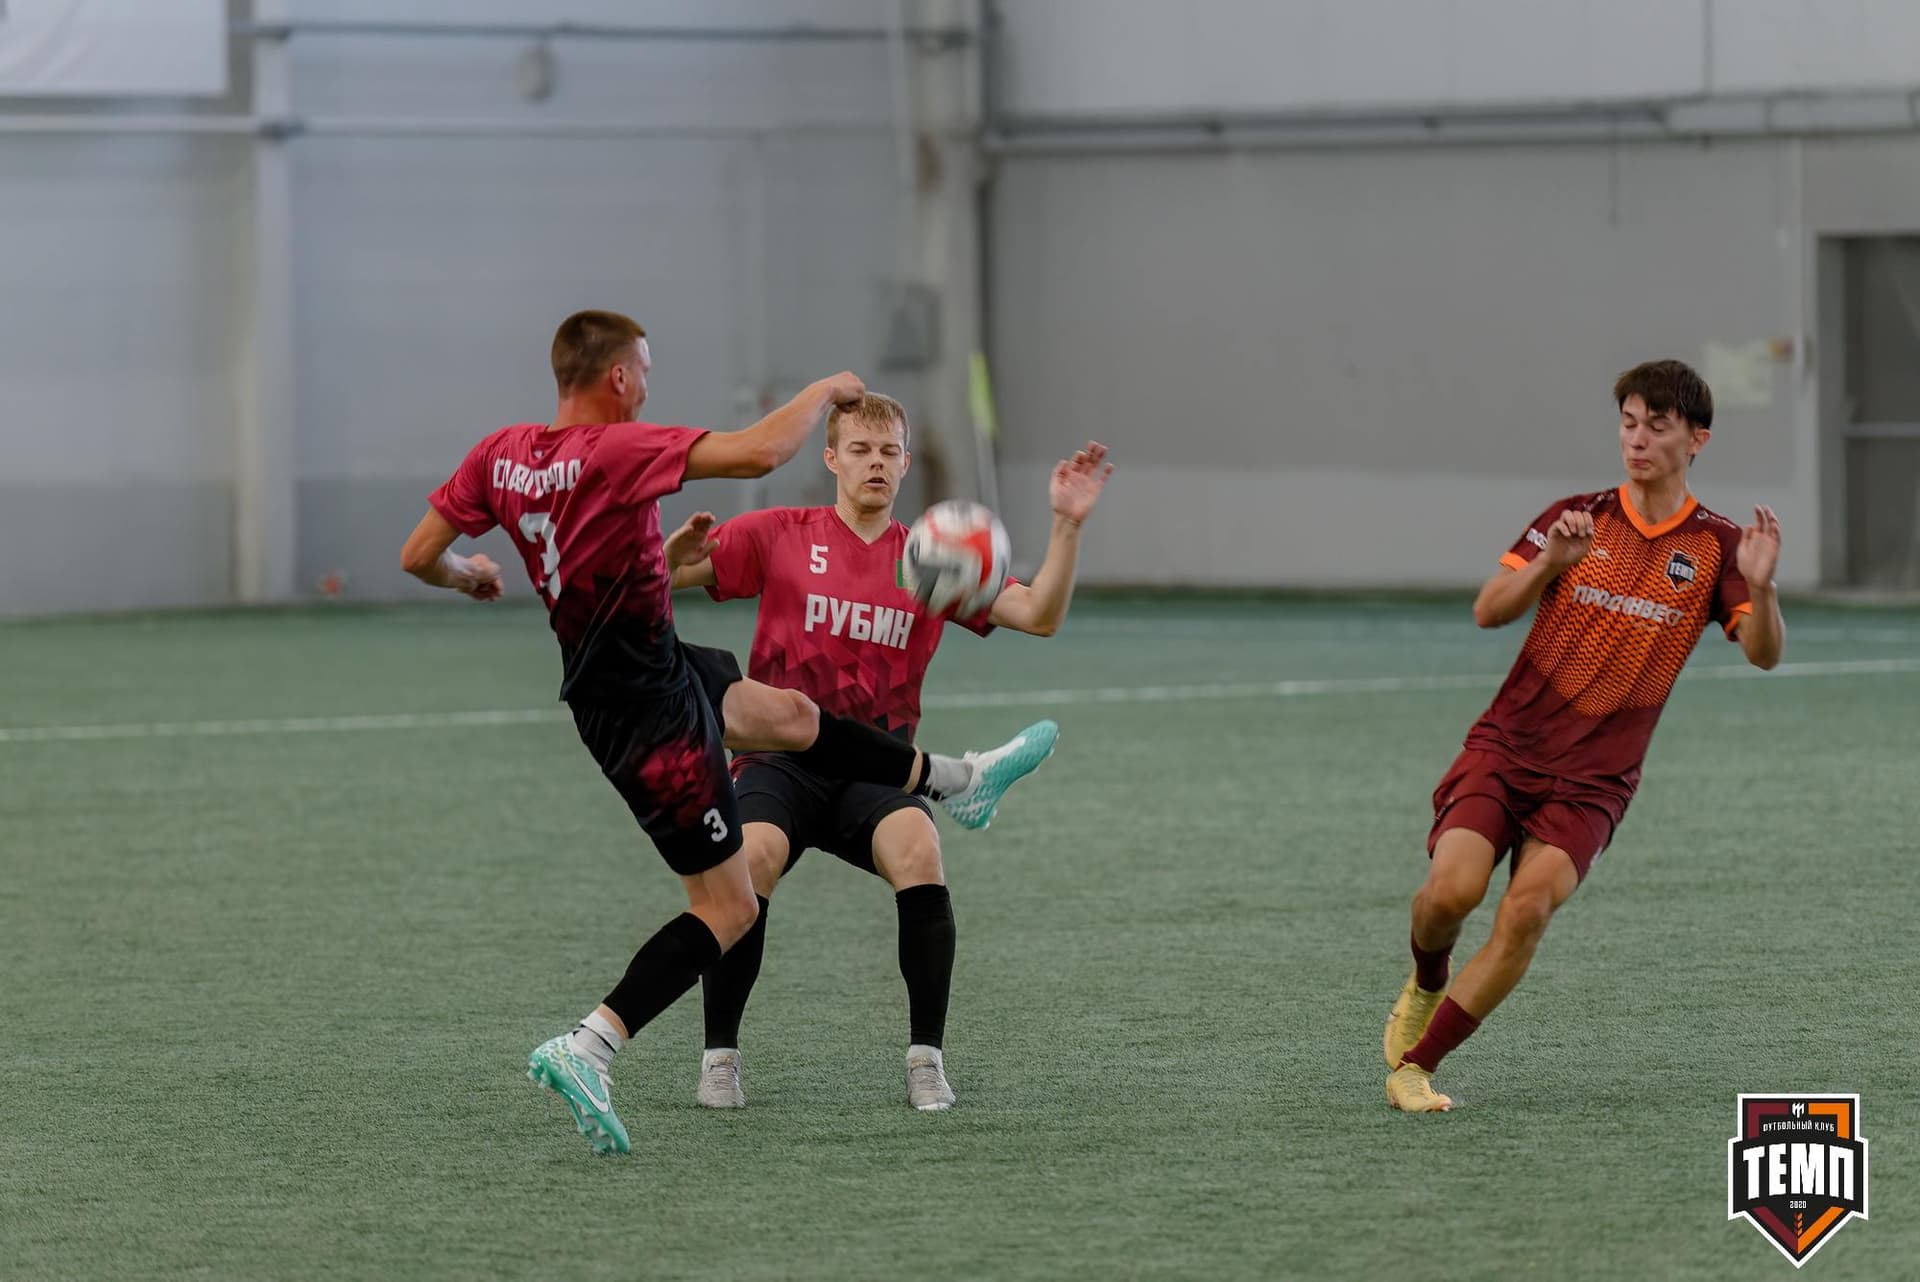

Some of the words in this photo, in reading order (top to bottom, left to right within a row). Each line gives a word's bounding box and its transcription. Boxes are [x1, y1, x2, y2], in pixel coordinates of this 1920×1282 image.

[518, 512, 562, 600] 3
[809, 543, 829, 574] 5
[804, 593, 915, 650] РУБИН
[703, 808, 728, 842] 3
